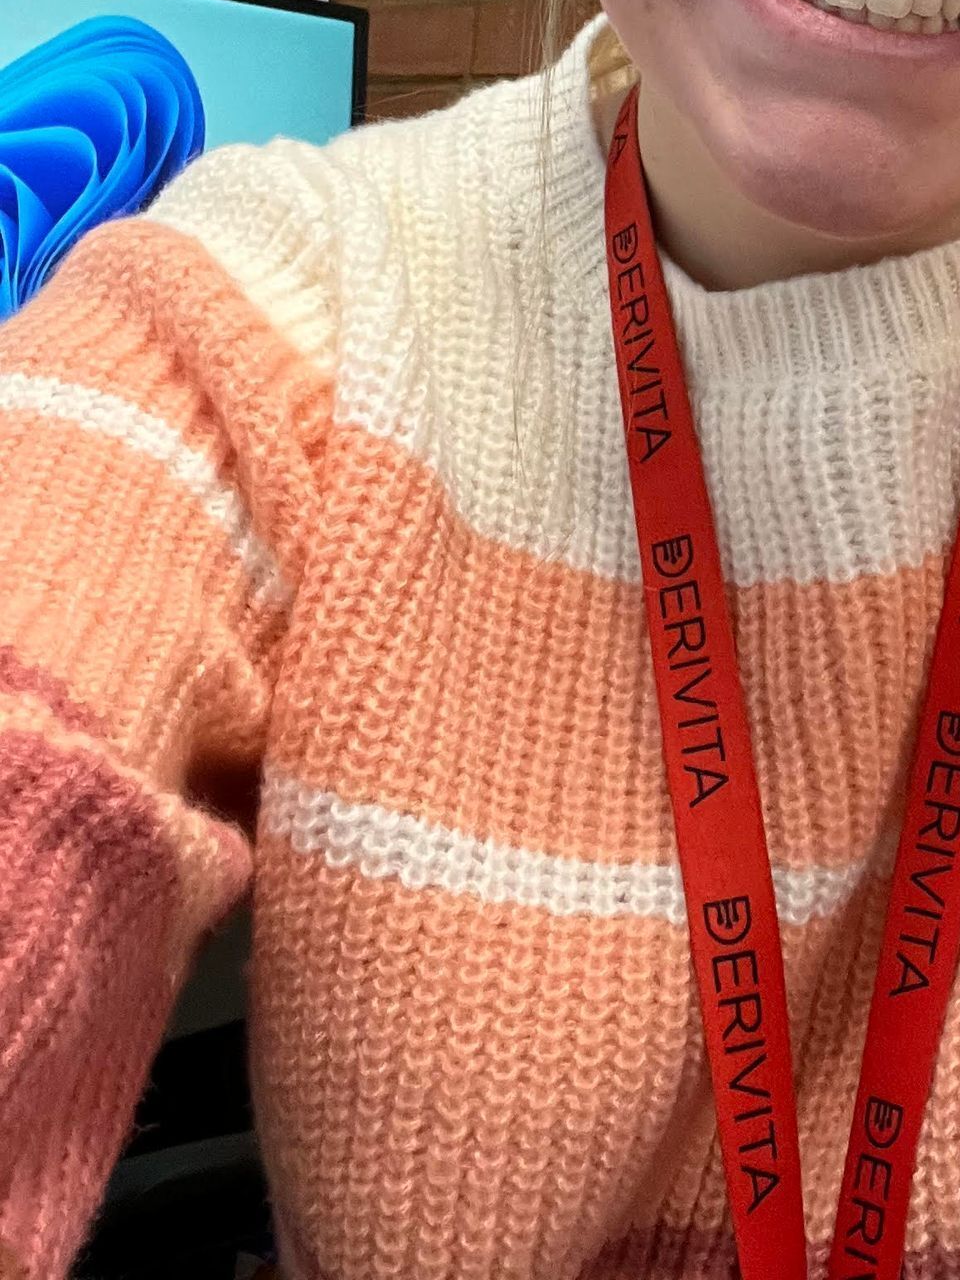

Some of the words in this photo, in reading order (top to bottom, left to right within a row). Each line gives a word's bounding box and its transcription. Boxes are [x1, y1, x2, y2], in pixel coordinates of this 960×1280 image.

[612, 222, 672, 463] DERIVITA
[650, 534, 729, 808] DERIVITA
[703, 895, 782, 1215] DERIVITA
[843, 1096, 904, 1280] DERI
